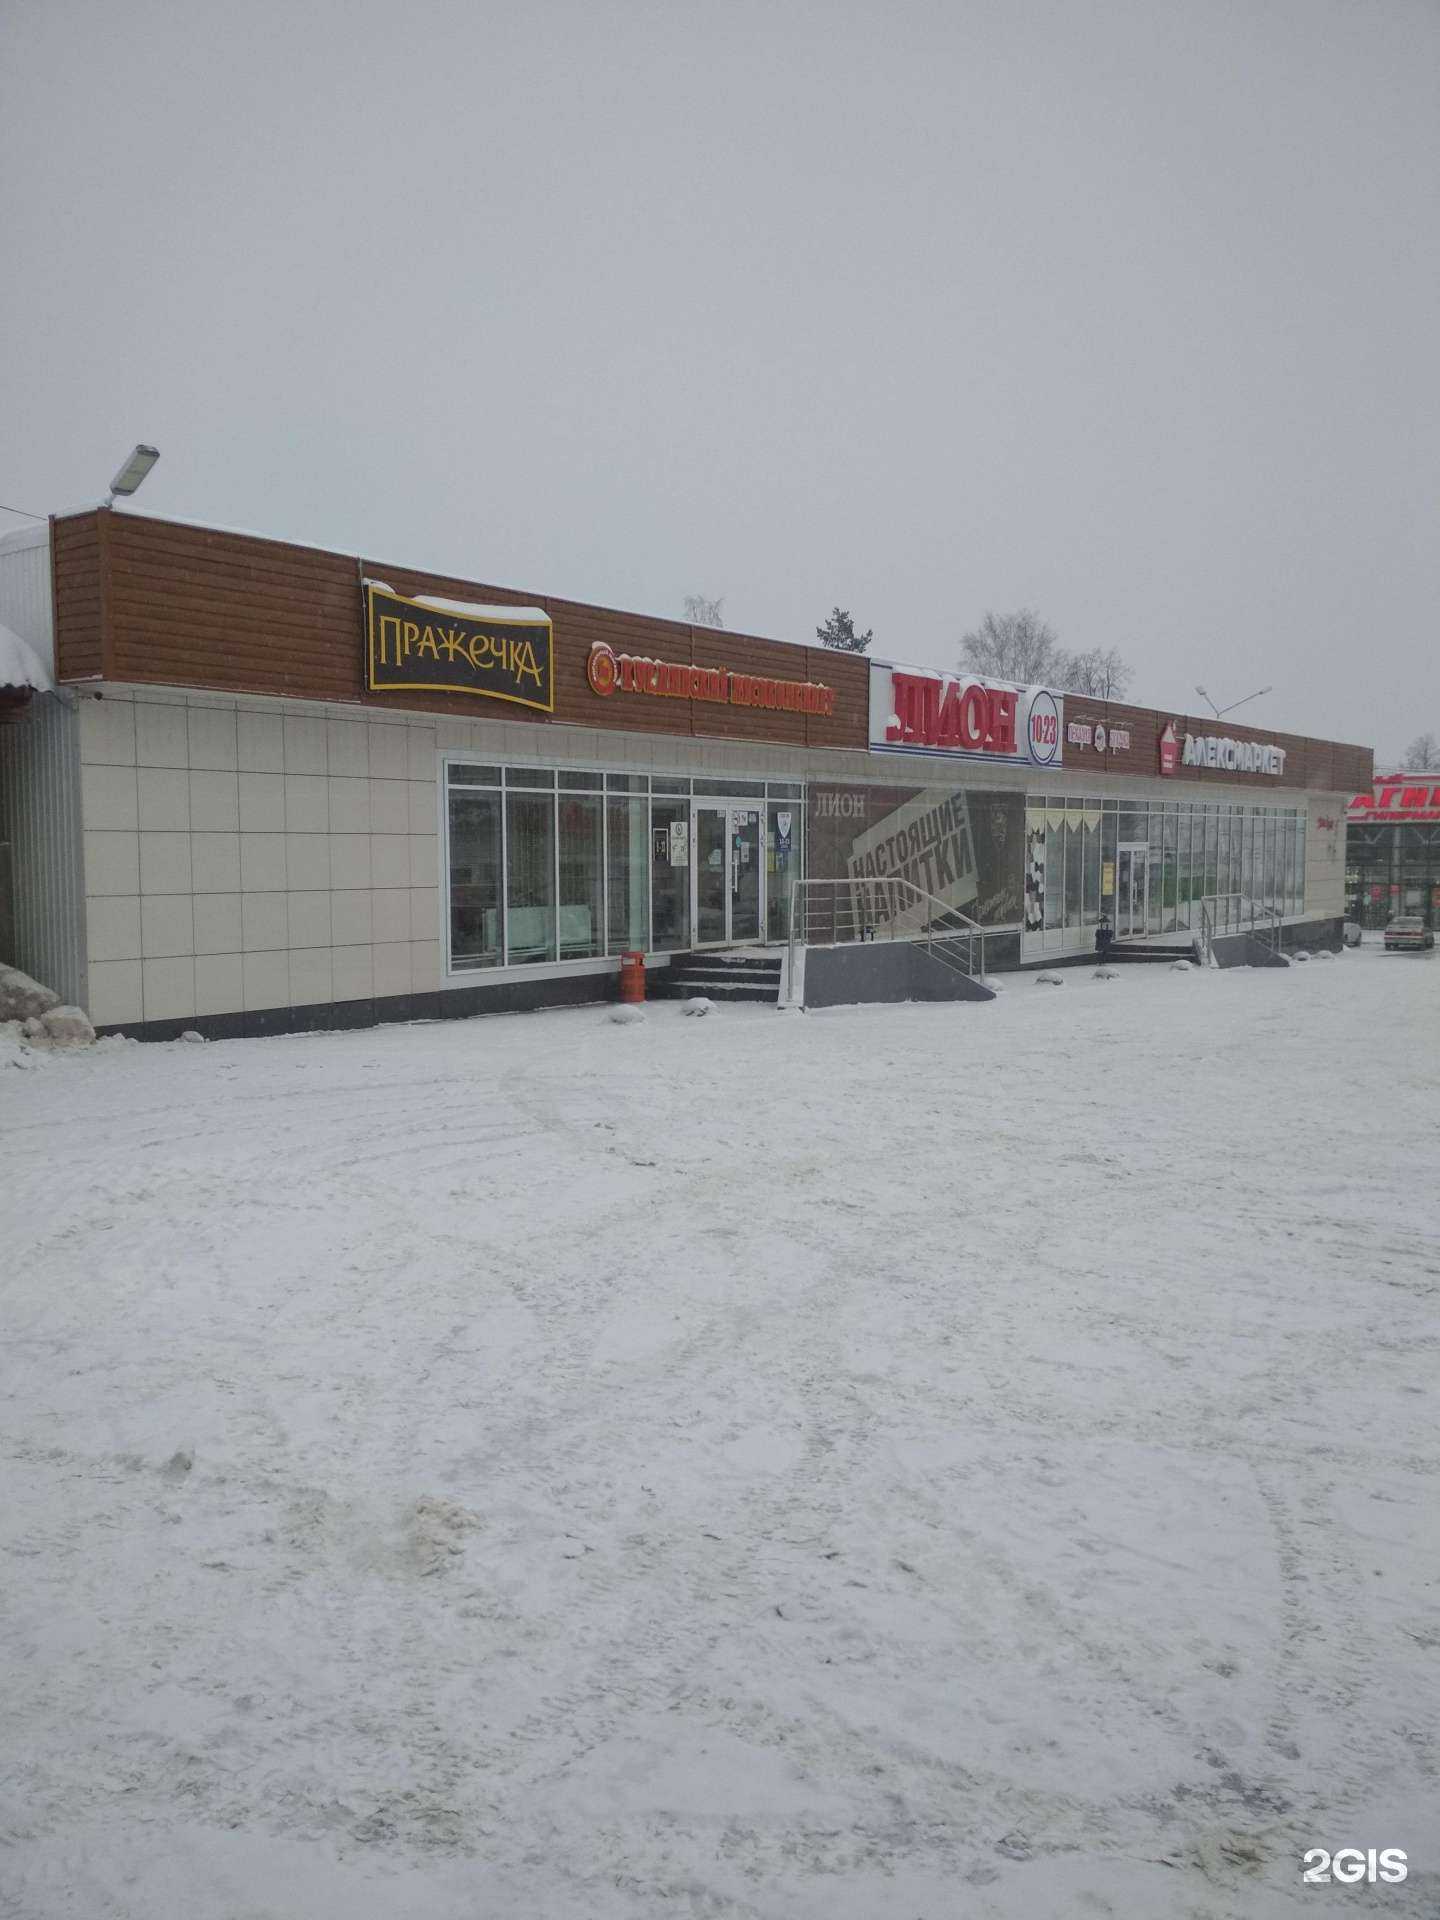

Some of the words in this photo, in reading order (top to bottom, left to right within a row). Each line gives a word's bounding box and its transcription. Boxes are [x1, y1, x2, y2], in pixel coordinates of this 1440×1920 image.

[886, 671, 1019, 753] ЛИОН
[815, 792, 866, 818] ЛИОН
[852, 790, 966, 880] НАСТОЯЩИЕ
